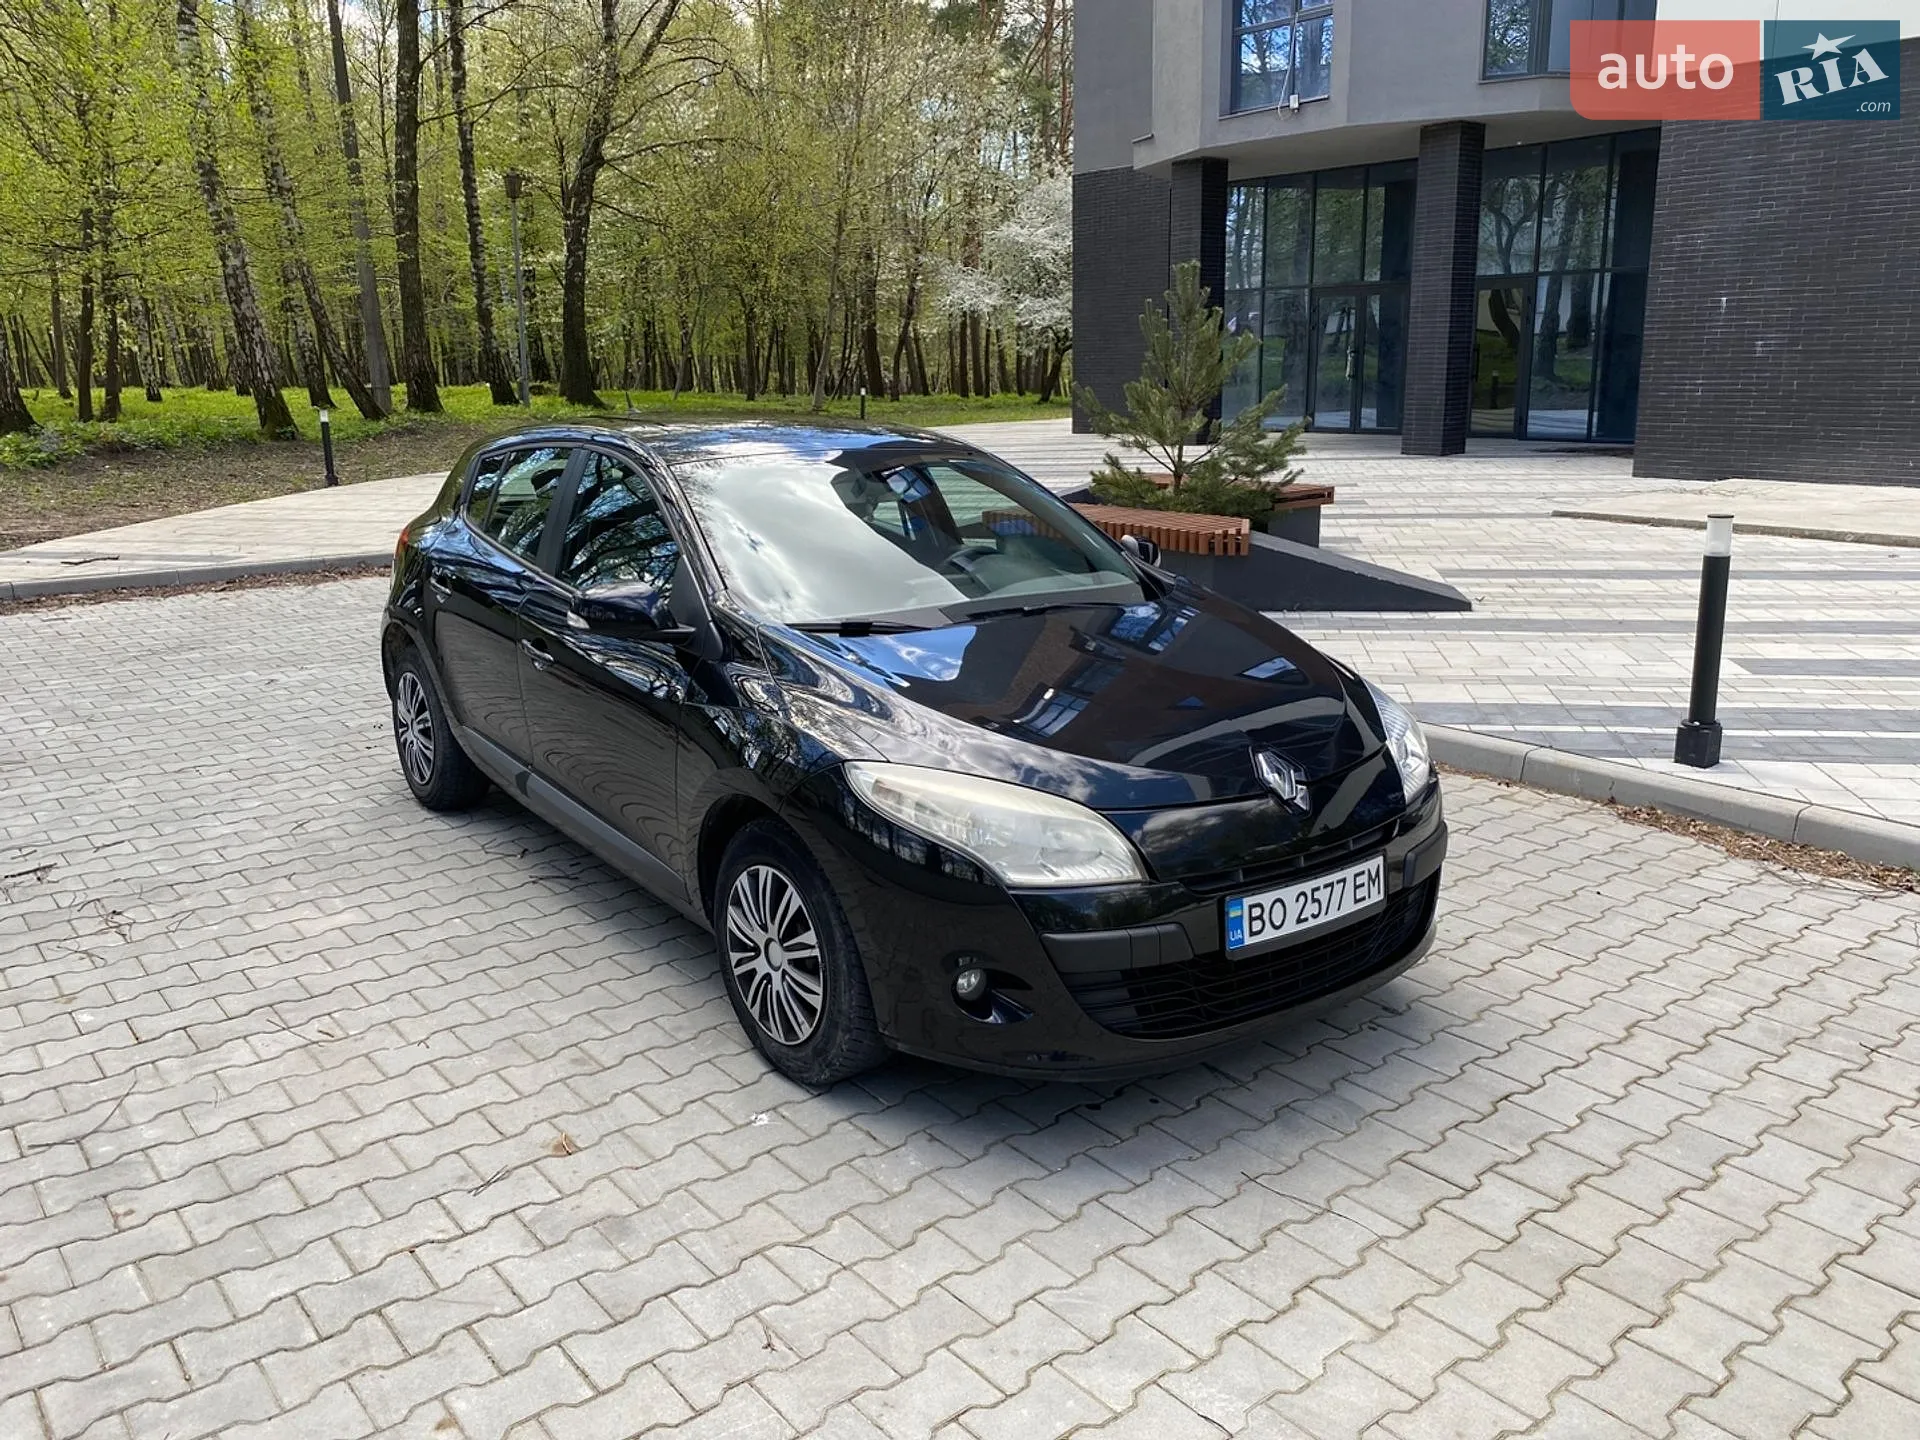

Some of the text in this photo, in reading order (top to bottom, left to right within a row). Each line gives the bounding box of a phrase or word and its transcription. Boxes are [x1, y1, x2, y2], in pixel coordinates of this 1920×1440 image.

[1248, 864, 1381, 937] BO 2577 EM
[1230, 929, 1243, 941] UA
